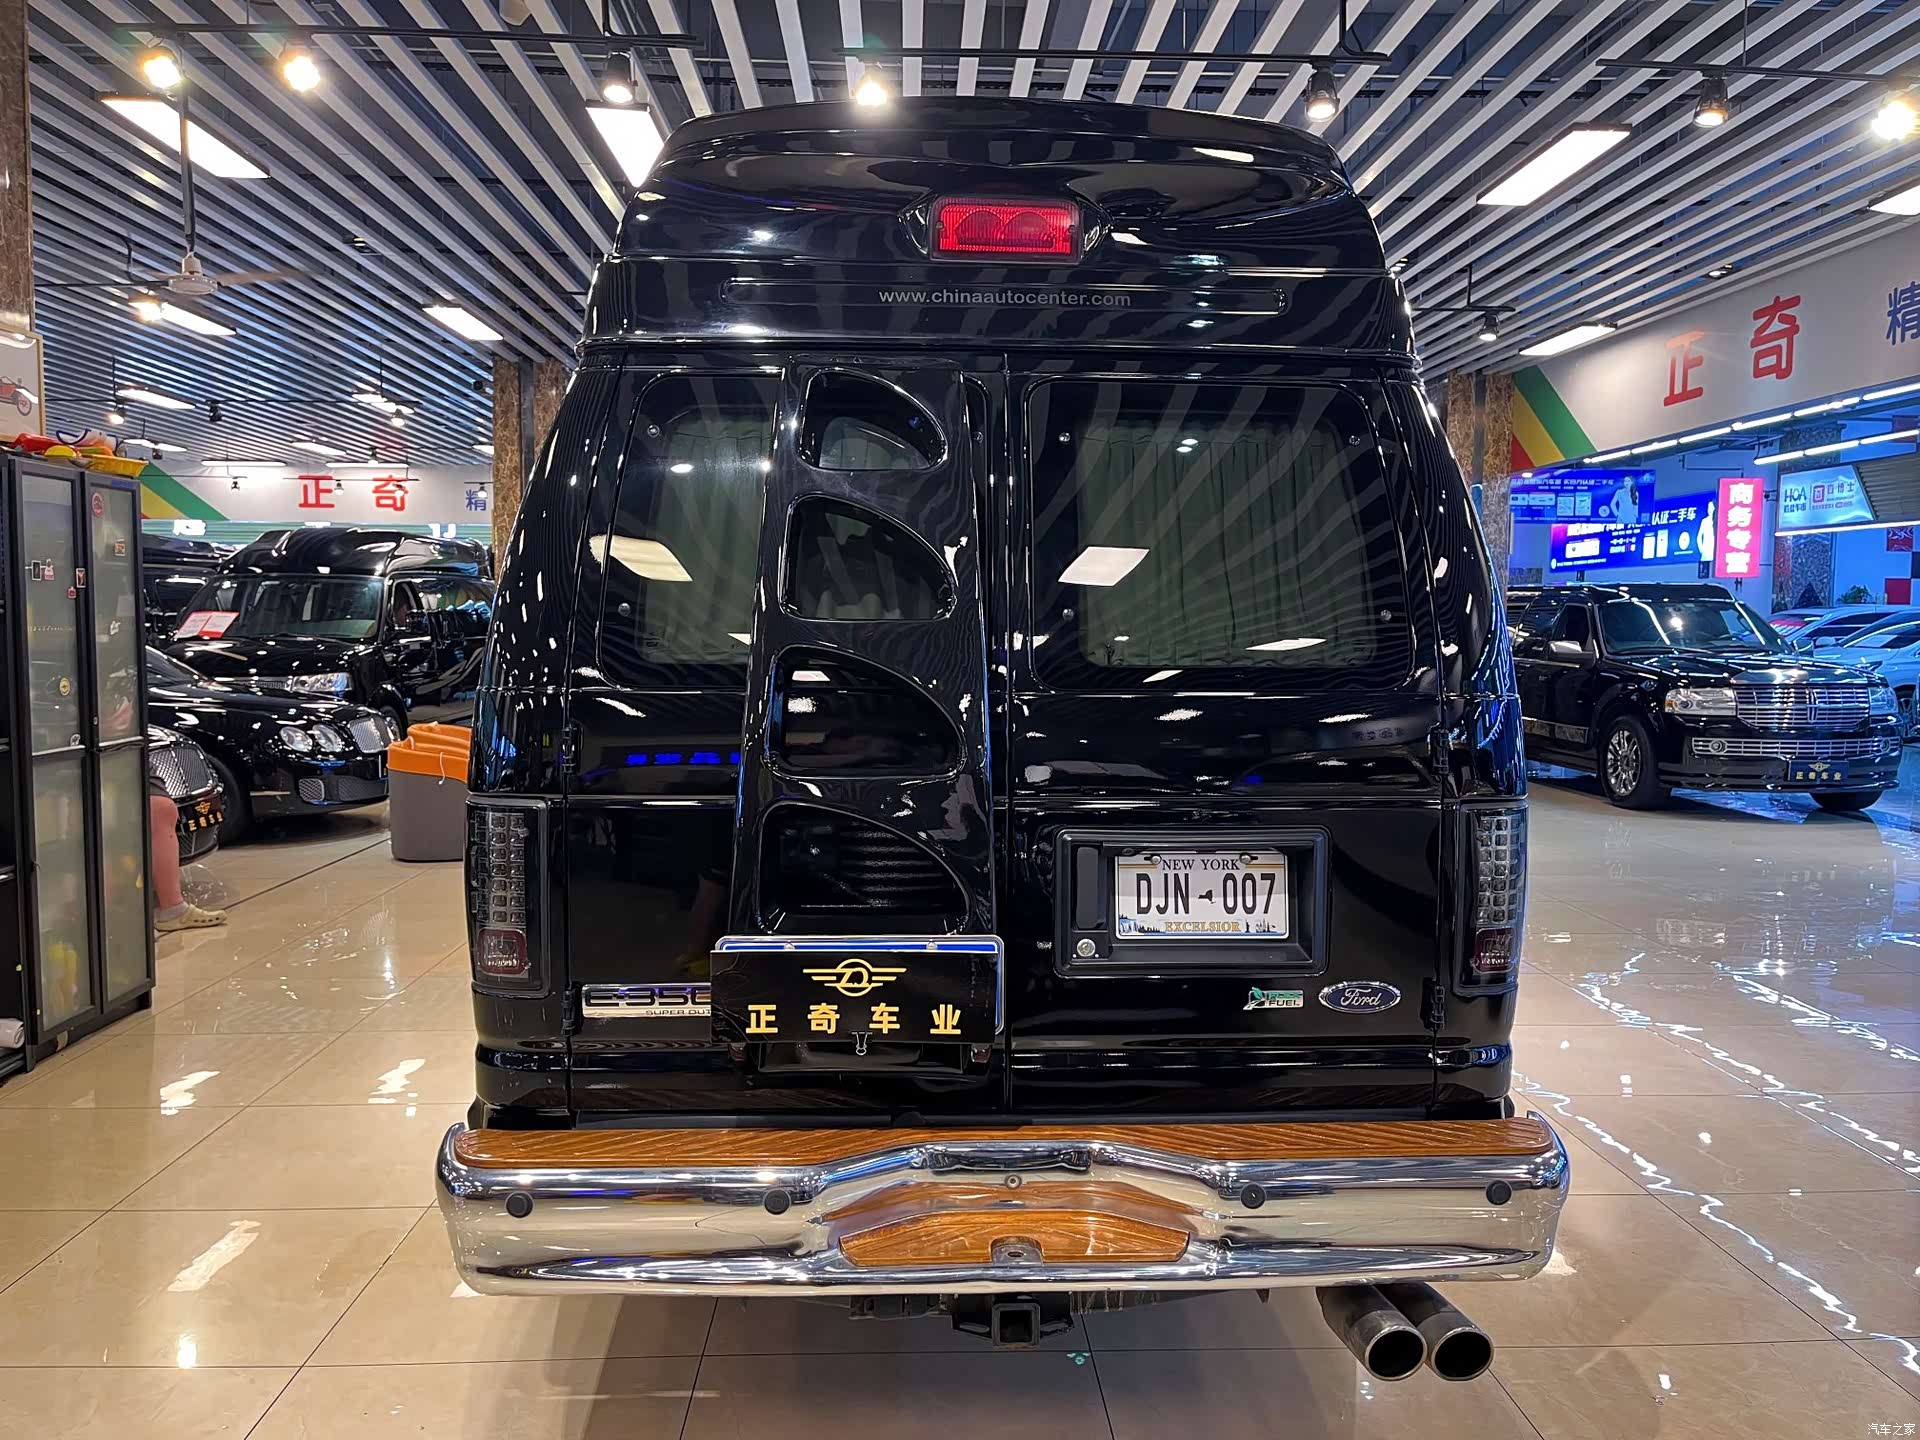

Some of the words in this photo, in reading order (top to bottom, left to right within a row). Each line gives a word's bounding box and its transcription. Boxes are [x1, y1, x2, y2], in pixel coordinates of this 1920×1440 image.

[878, 289, 1131, 306] www.chinaautocenter.com
[1664, 295, 1801, 407] 正奇
[298, 475, 409, 511] 正奇
[1162, 859, 1195, 870] NEW
[1200, 859, 1240, 870] YORK
[1136, 873, 1190, 914] DJN
[1222, 873, 1276, 914] 007
[1165, 921, 1242, 932] EXCELSIOR
[1341, 988, 1382, 1006] Ford
[746, 1003, 961, 1035] 正奇车业
